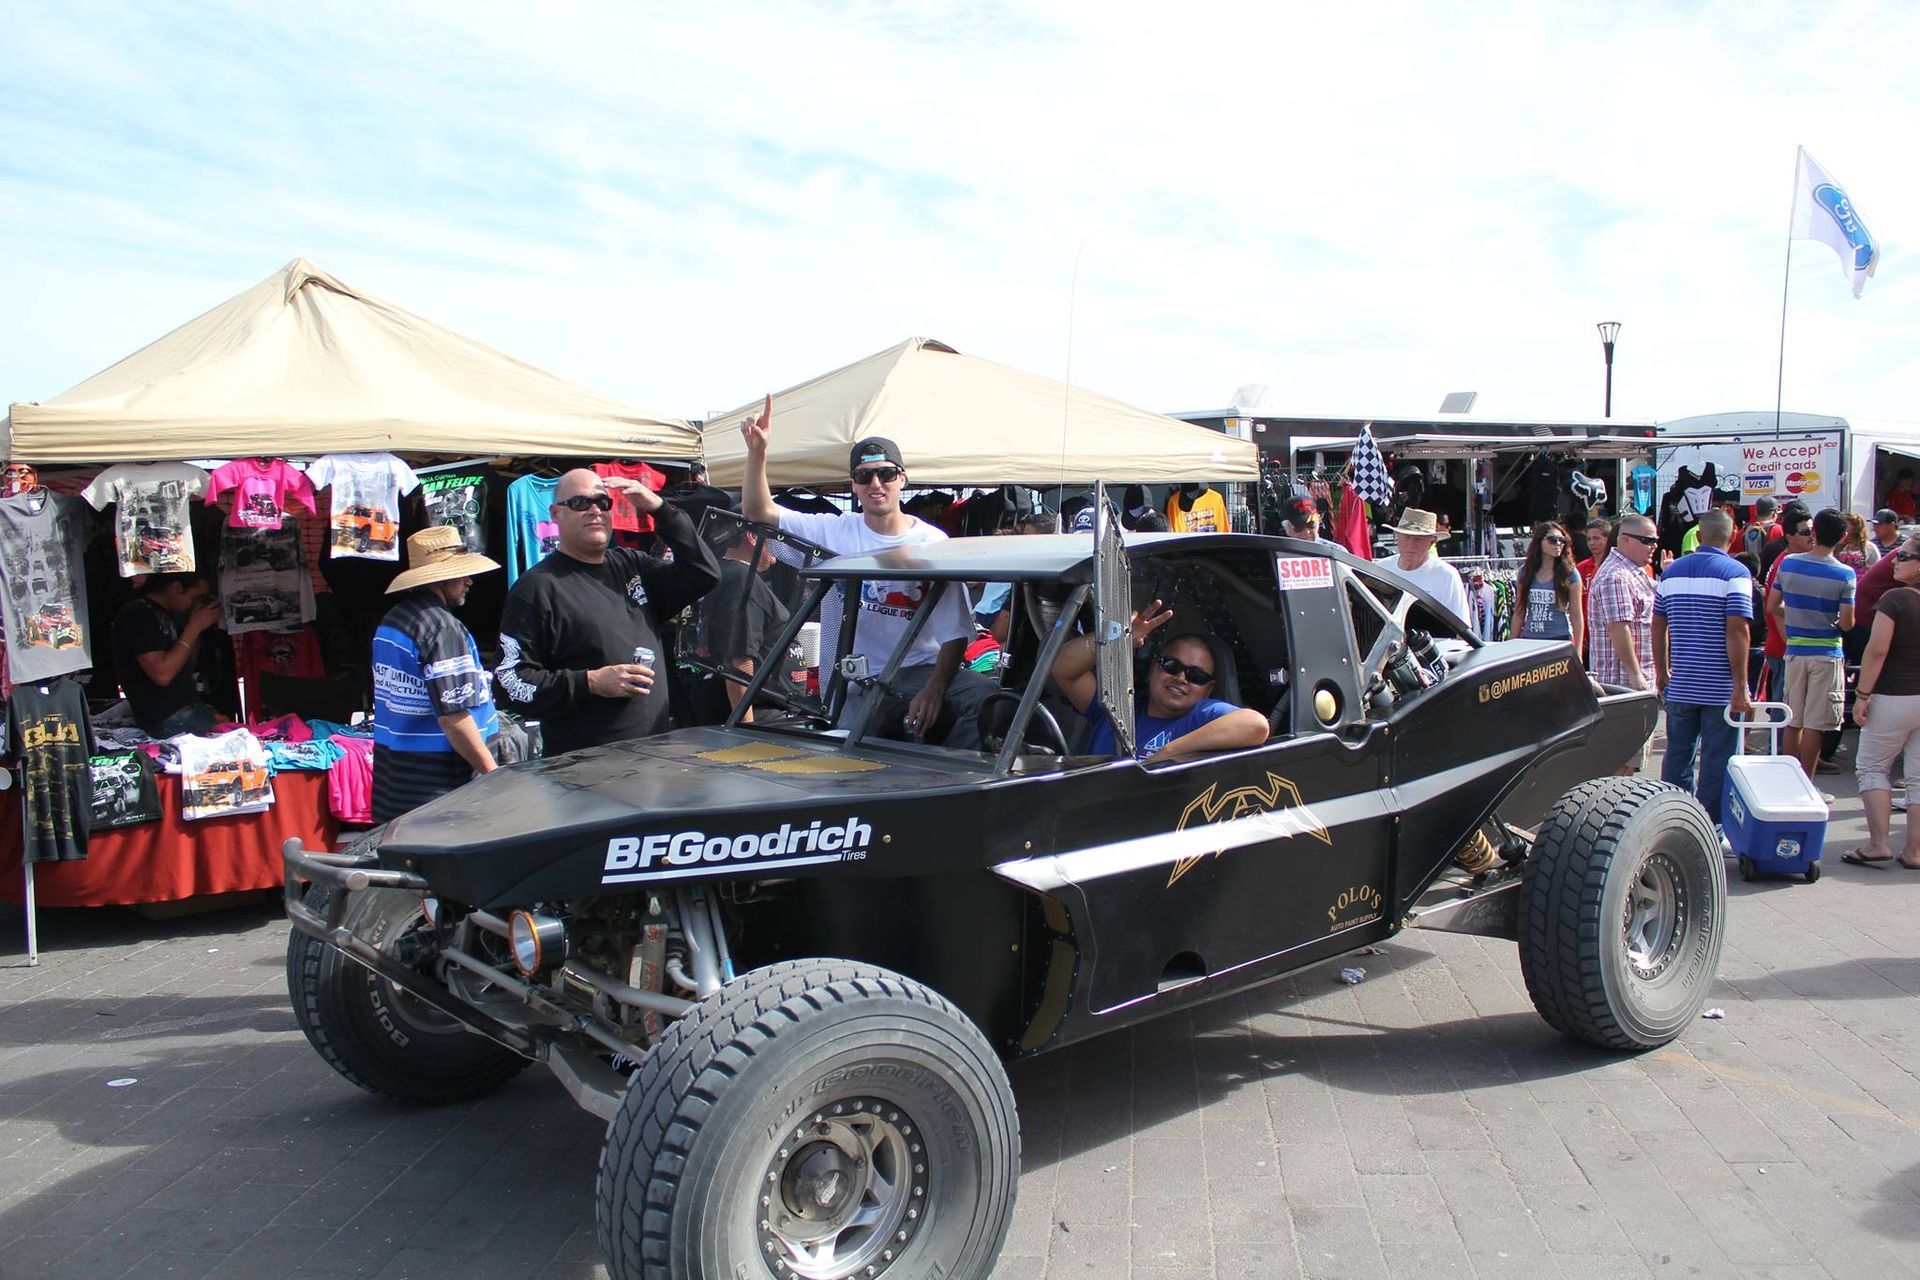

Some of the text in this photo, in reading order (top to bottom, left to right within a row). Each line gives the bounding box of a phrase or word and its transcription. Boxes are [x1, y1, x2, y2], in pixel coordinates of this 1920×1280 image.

[1743, 443, 1822, 459] We Accept
[1748, 459, 1817, 473] Credit cards
[446, 476, 484, 489] FELIPE
[1749, 480, 1770, 489] VISA
[1281, 559, 1330, 579] SCORE
[1530, 592, 1554, 602] GIRLS
[1532, 612, 1554, 621] MORE
[1530, 622, 1545, 633] FUN
[604, 816, 872, 871] BFGoodrich
[842, 849, 867, 861] Tires
[1328, 884, 1382, 921] POLO'S
